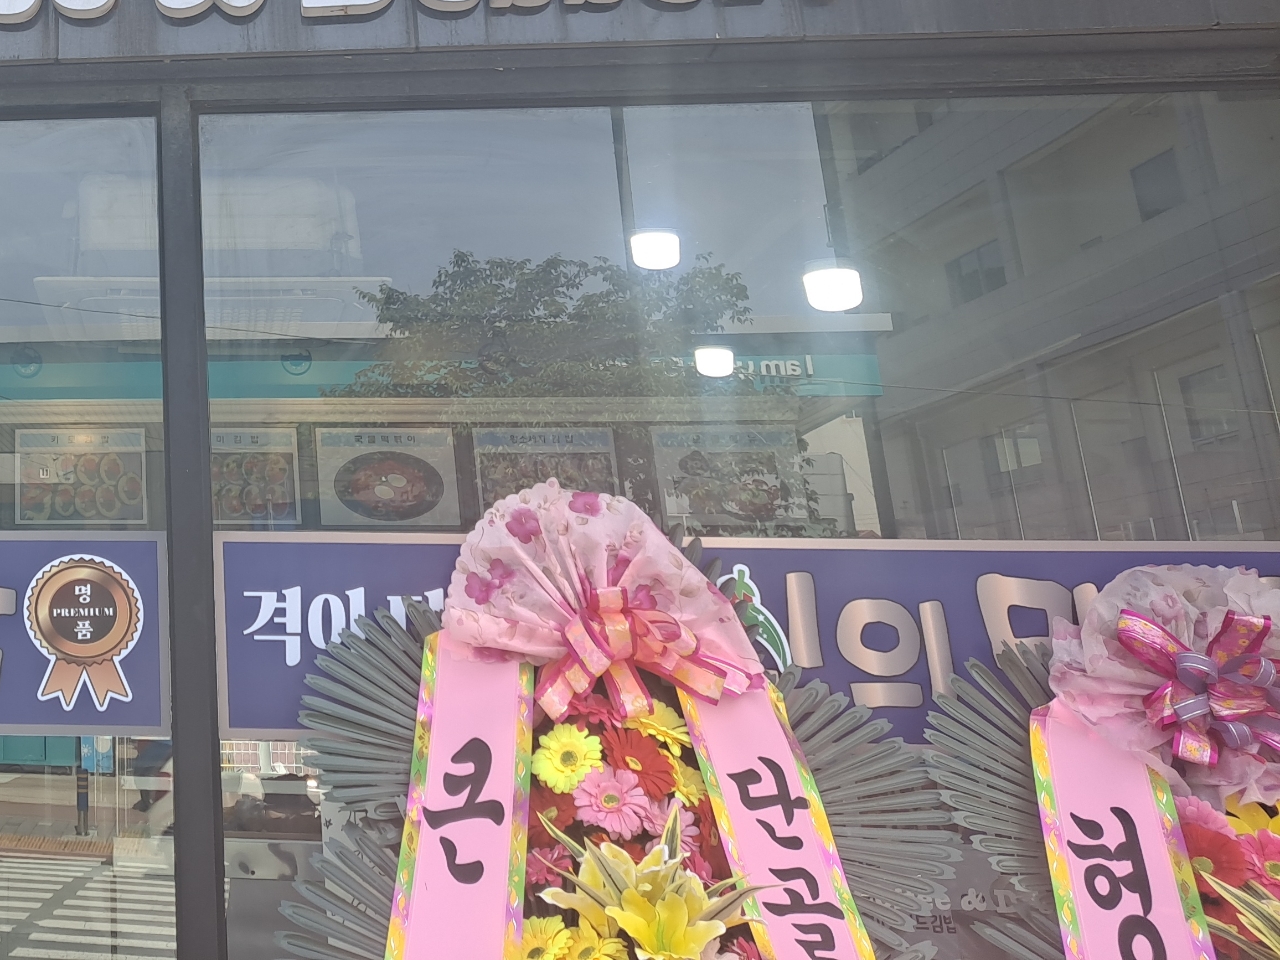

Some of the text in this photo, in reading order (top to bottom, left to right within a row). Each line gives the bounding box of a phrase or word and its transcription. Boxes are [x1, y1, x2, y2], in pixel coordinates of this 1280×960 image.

[74, 583, 91, 604] 명
[52, 606, 115, 618] PREMIUM
[73, 620, 94, 640] 품
[422, 737, 505, 886] 큰
